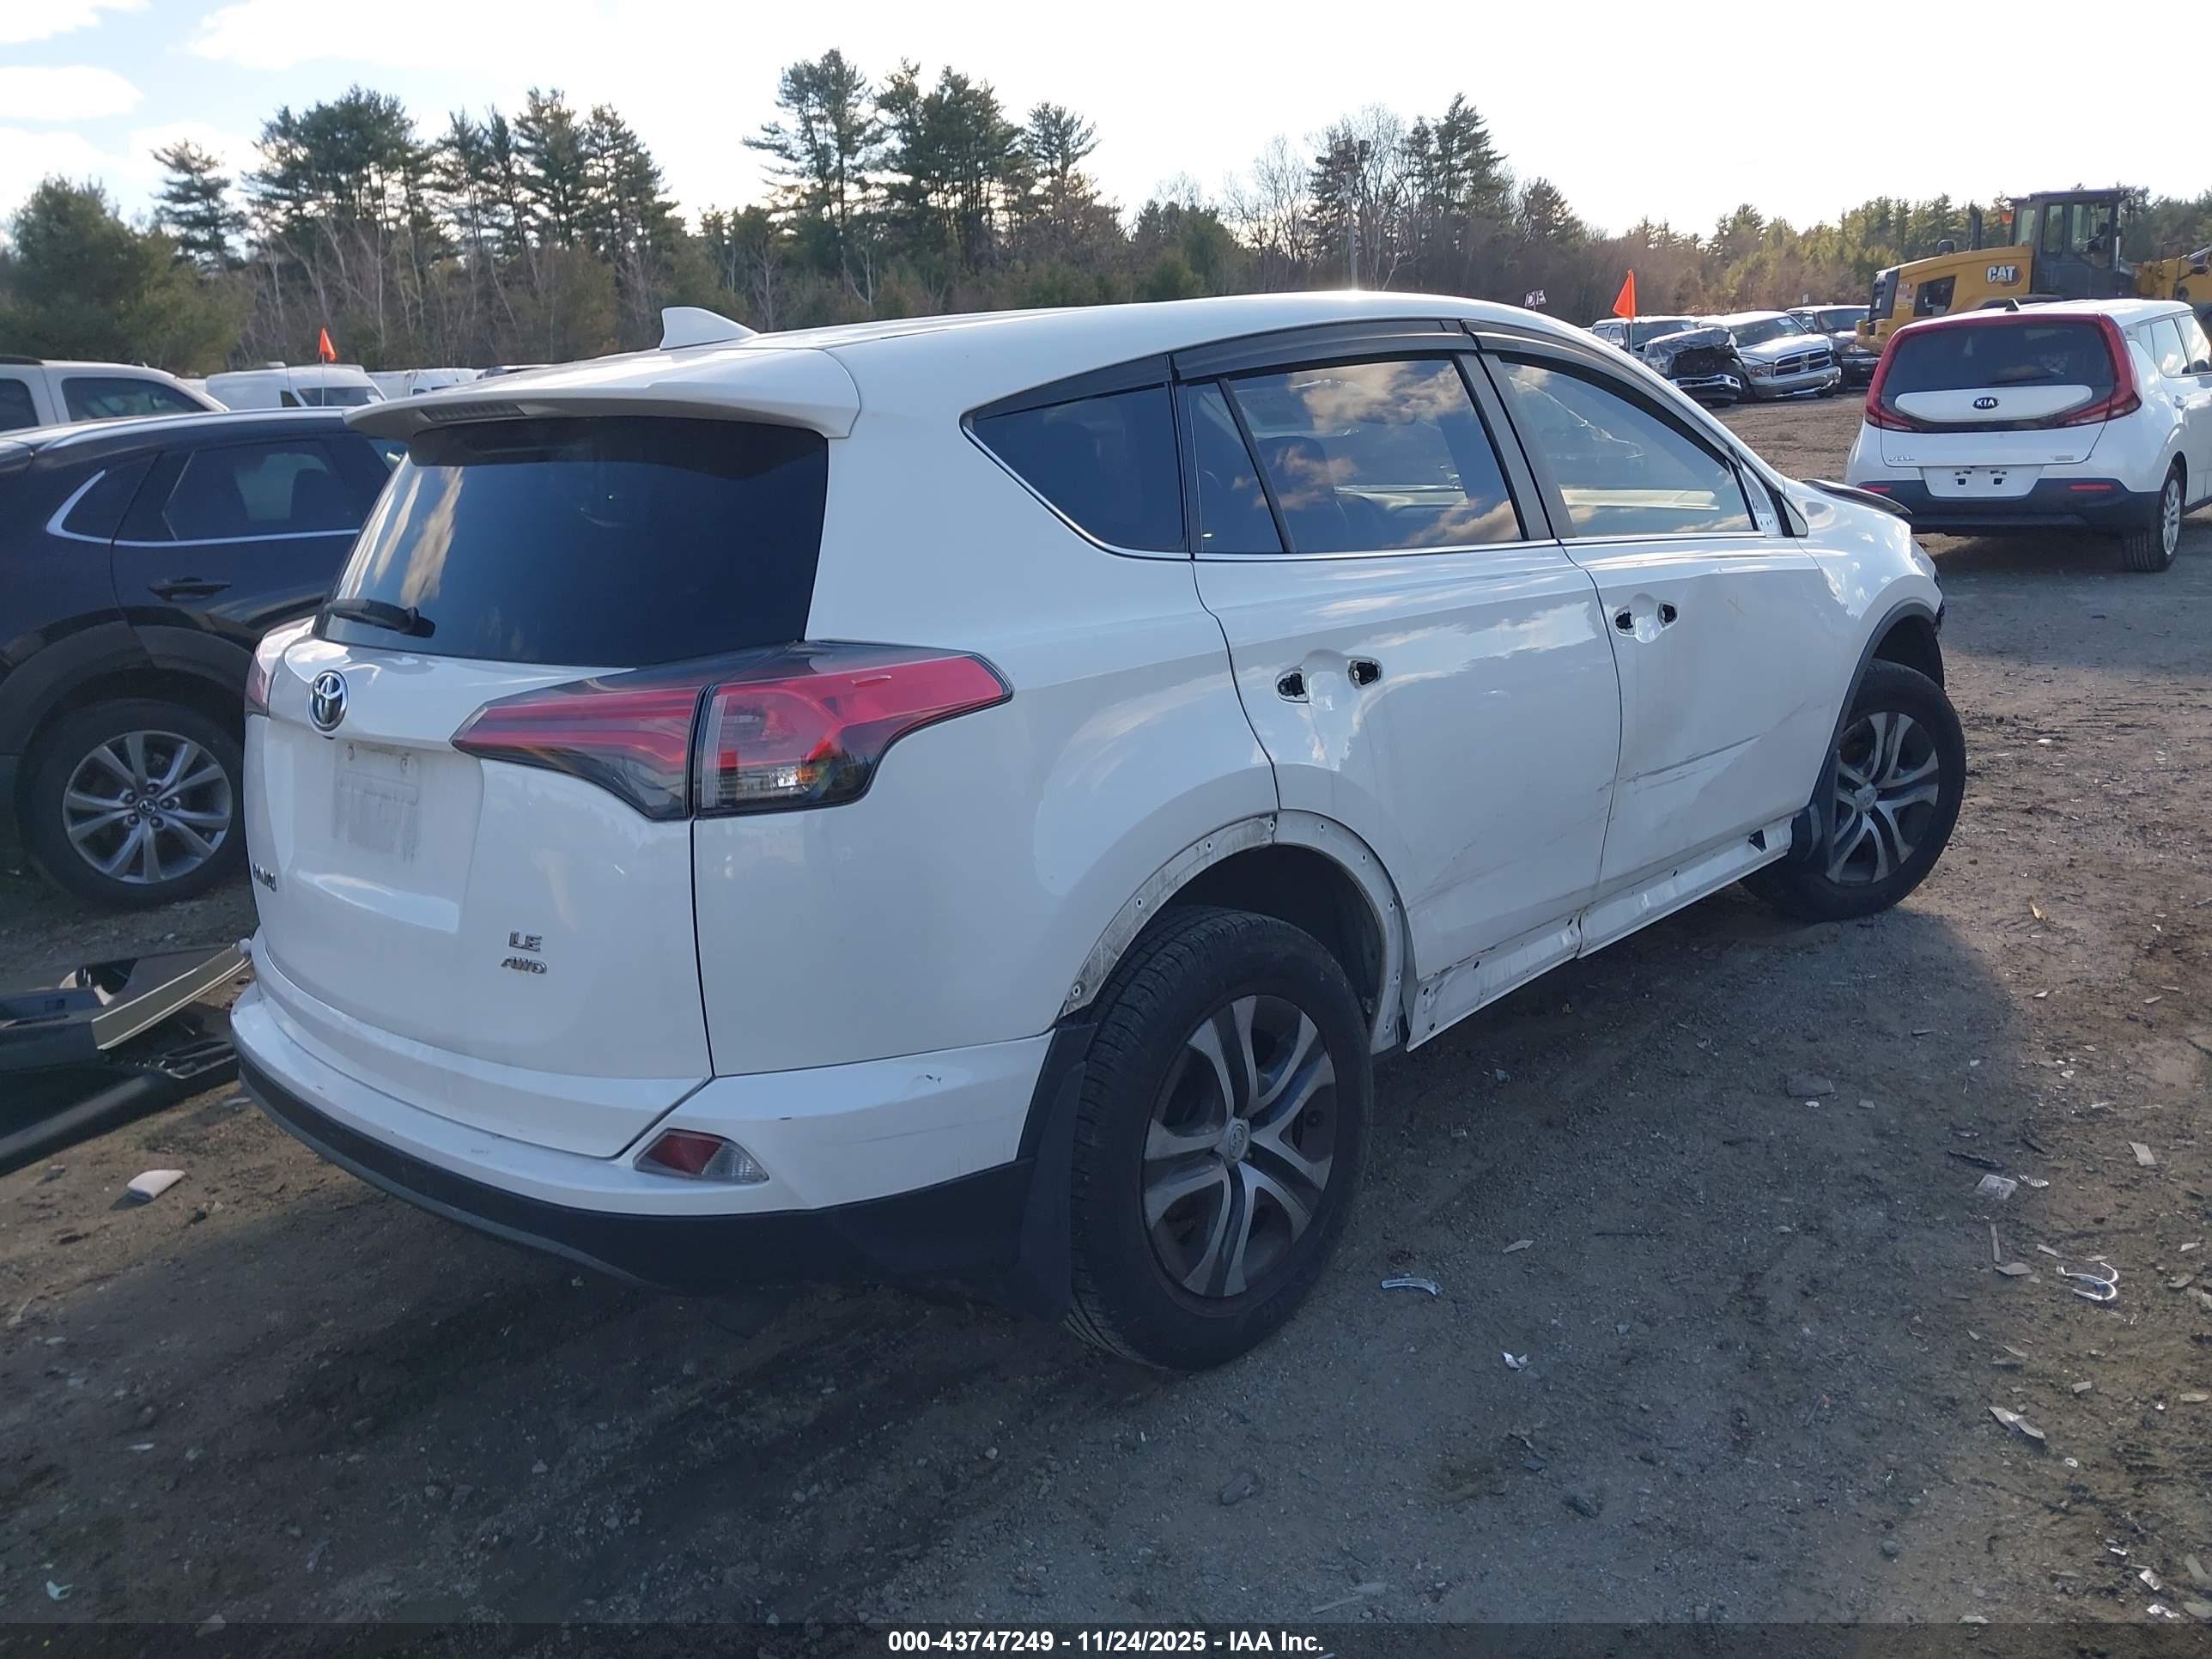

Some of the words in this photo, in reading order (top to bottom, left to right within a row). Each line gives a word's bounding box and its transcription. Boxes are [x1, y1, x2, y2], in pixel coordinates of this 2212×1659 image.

[1987, 265, 2015, 283] CAT
[509, 932, 542, 952] LE
[501, 957, 547, 975] AWD
